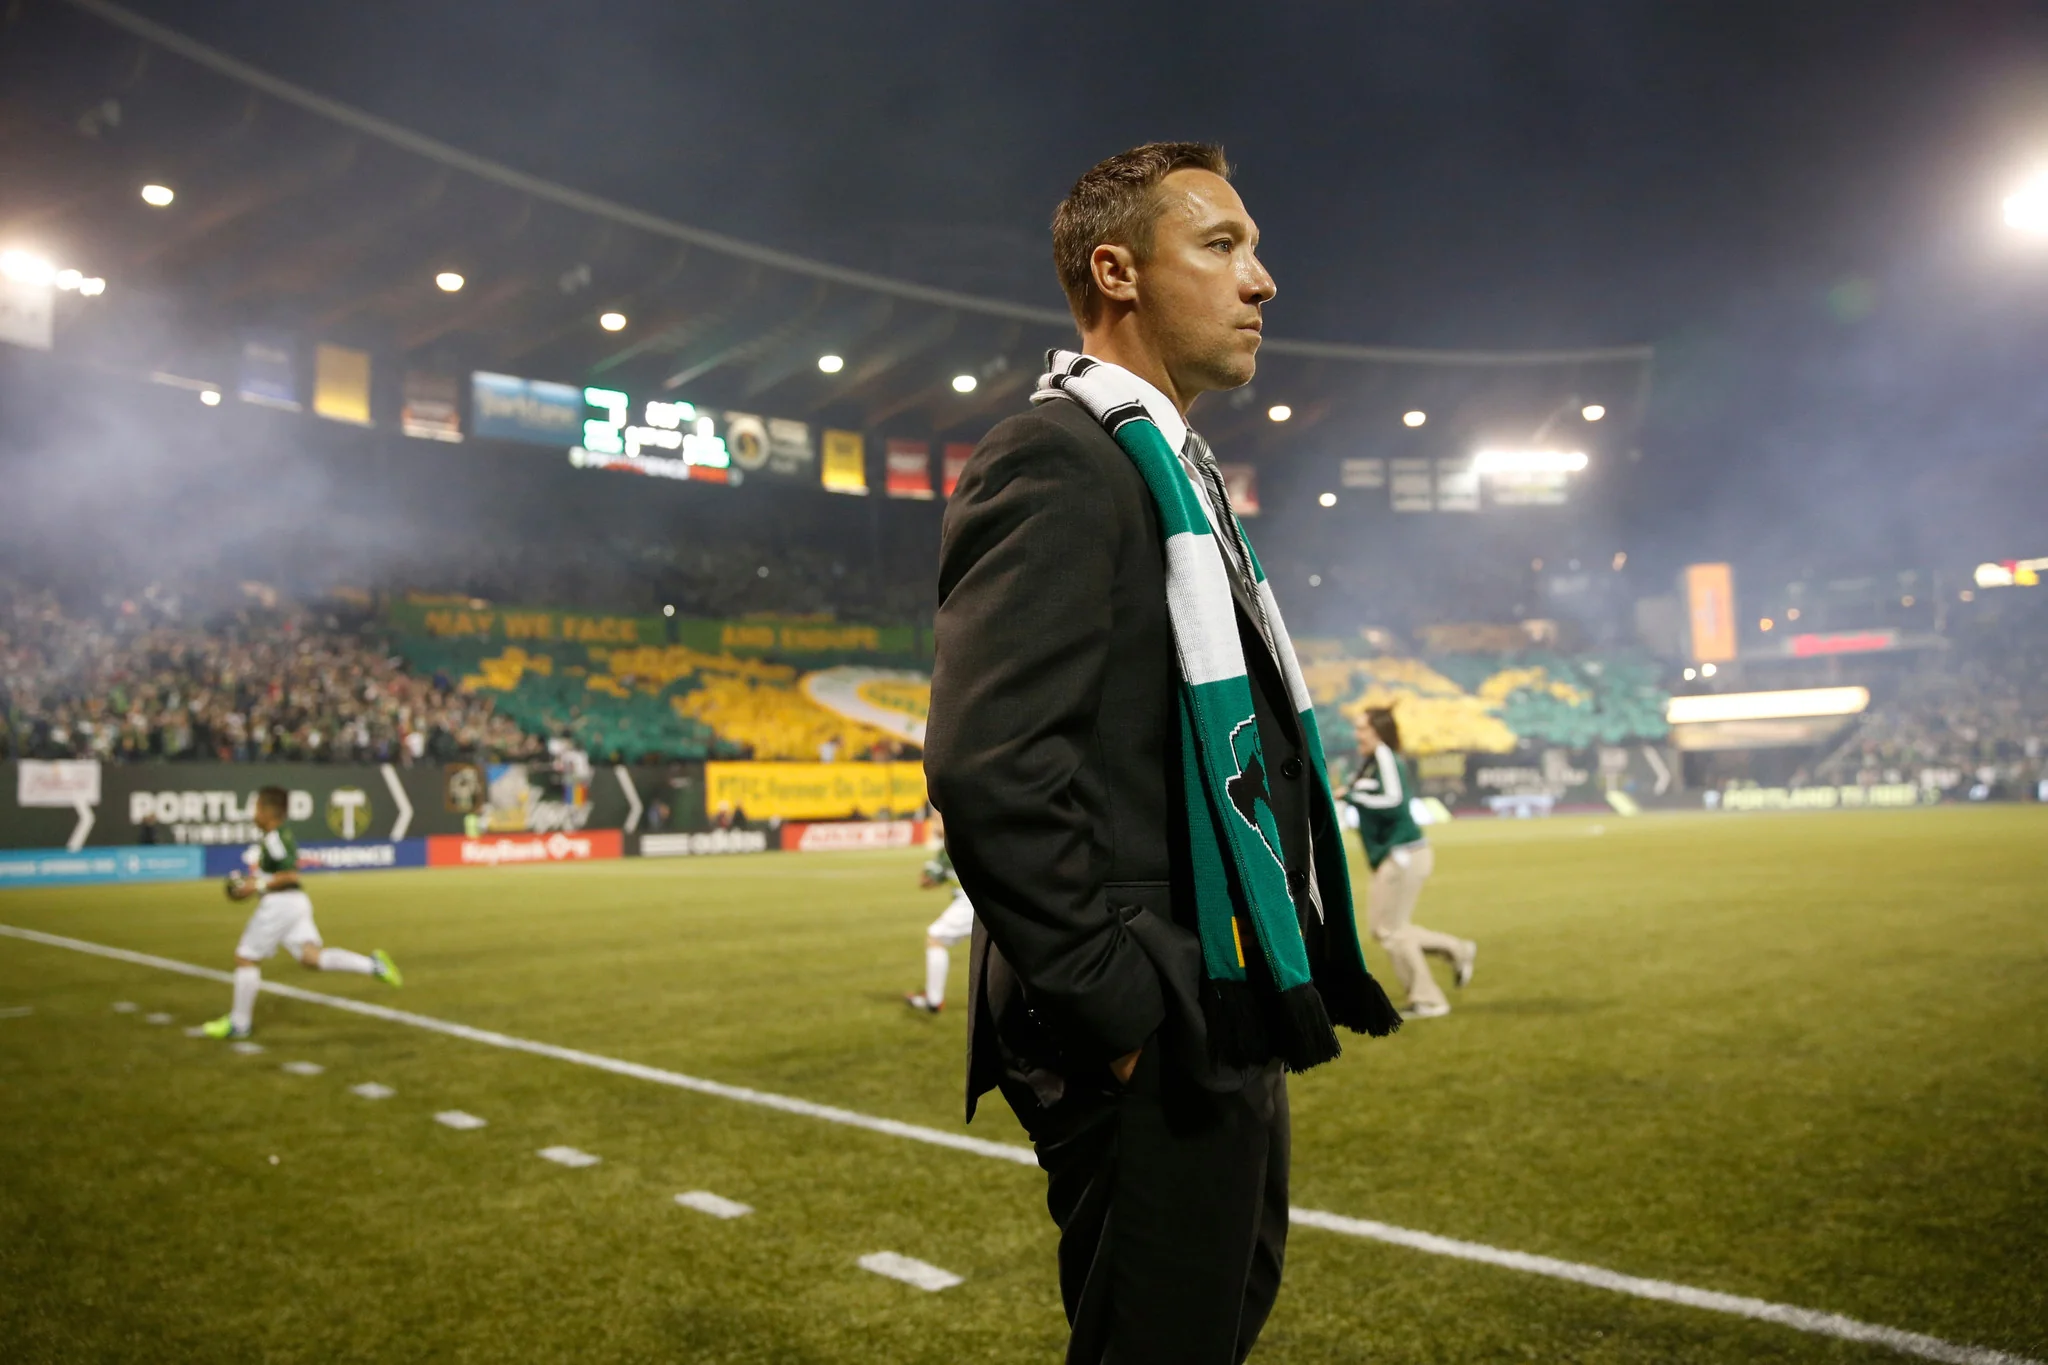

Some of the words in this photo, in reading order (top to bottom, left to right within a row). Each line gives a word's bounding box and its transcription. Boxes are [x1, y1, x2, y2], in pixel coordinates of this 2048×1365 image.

[129, 790, 314, 824] PORTLAD
[171, 823, 264, 844] TIMBER
[691, 829, 766, 854] adidas
[460, 840, 548, 865] KeyBank
